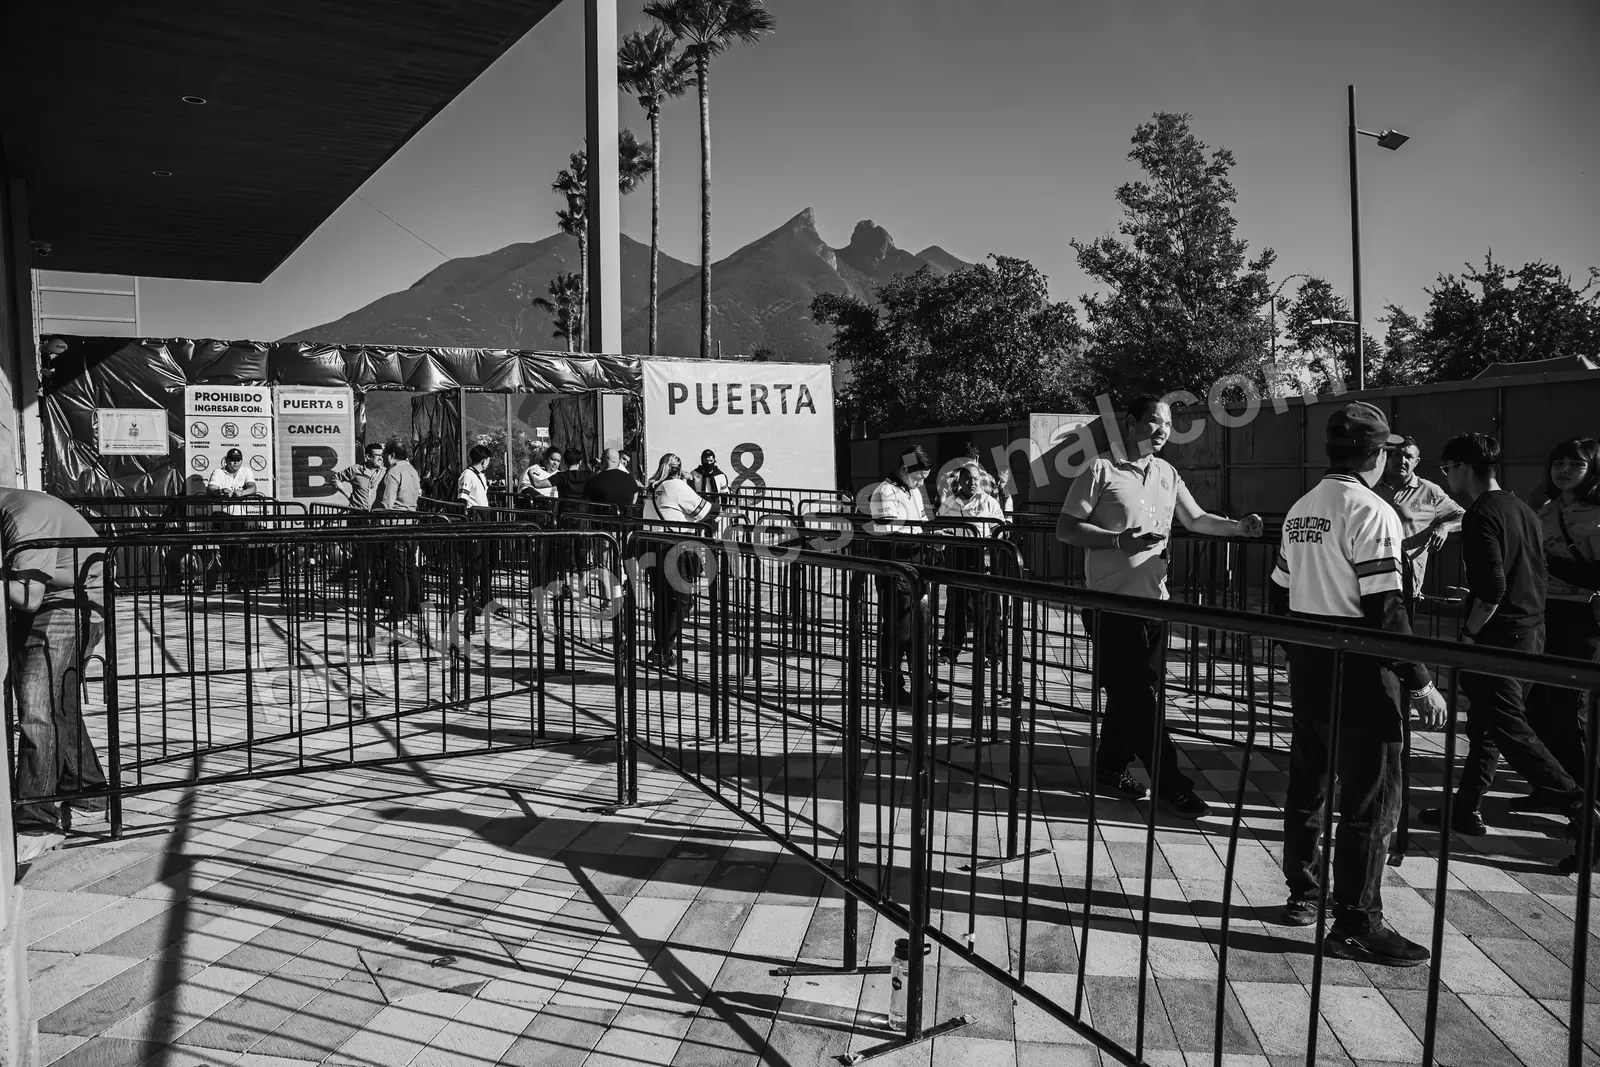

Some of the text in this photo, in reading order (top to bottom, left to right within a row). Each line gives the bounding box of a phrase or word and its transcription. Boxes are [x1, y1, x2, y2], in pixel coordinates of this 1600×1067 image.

[194, 391, 263, 403] PROHIBIDO
[283, 399, 344, 409] PUERTA 8
[668, 383, 817, 415] PUERTA
[194, 404, 263, 413] INGRESAR CON:
[287, 424, 341, 434] CANCHA
[291, 445, 339, 498] B
[730, 442, 766, 506] 8
[1285, 516, 1331, 533] SEGURIDAD
